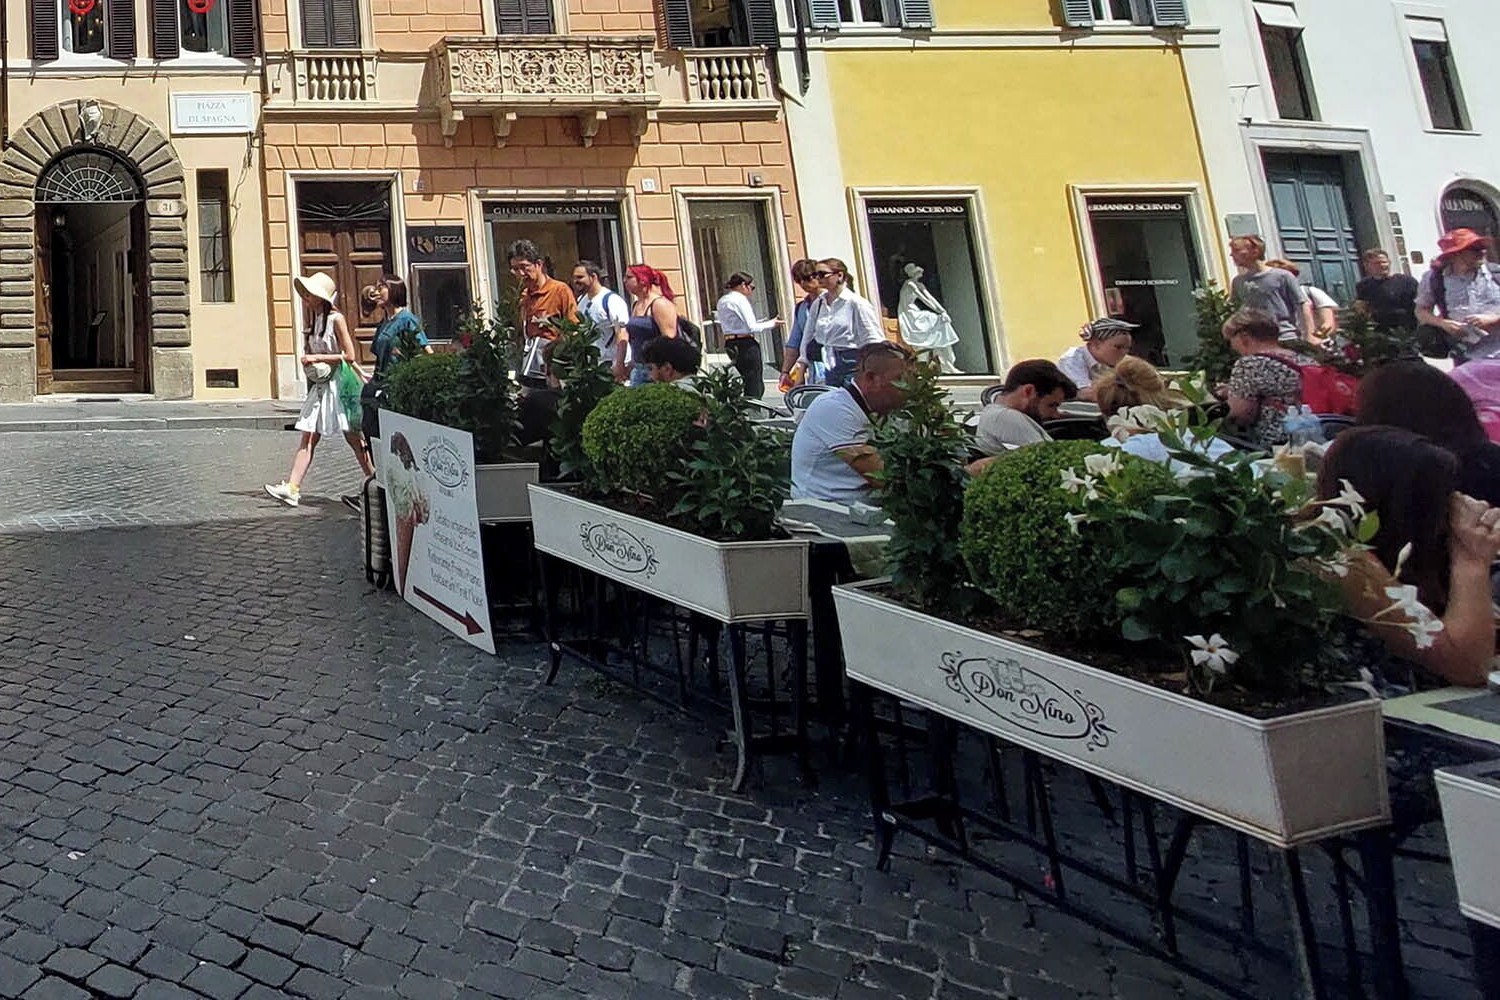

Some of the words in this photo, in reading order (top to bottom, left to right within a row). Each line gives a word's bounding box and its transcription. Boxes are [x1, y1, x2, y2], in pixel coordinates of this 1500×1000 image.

[197, 102, 227, 110] PIAZZA
[188, 115, 198, 123] DI
[202, 115, 237, 123] SPAGNA
[162, 203, 172, 211] 31
[493, 206, 548, 215] GIUSEPPE
[556, 206, 608, 214] ZANOTTI
[868, 206, 915, 214] ERMANNO
[916, 205, 964, 213] SCERVINO
[1088, 204, 1134, 212] ERMANNO
[1135, 203, 1182, 211] SCERVINO
[595, 533, 615, 553] Don
[616, 544, 642, 563] Nino
[971, 671, 1016, 703] Don
[1019, 693, 1076, 725] Nino
